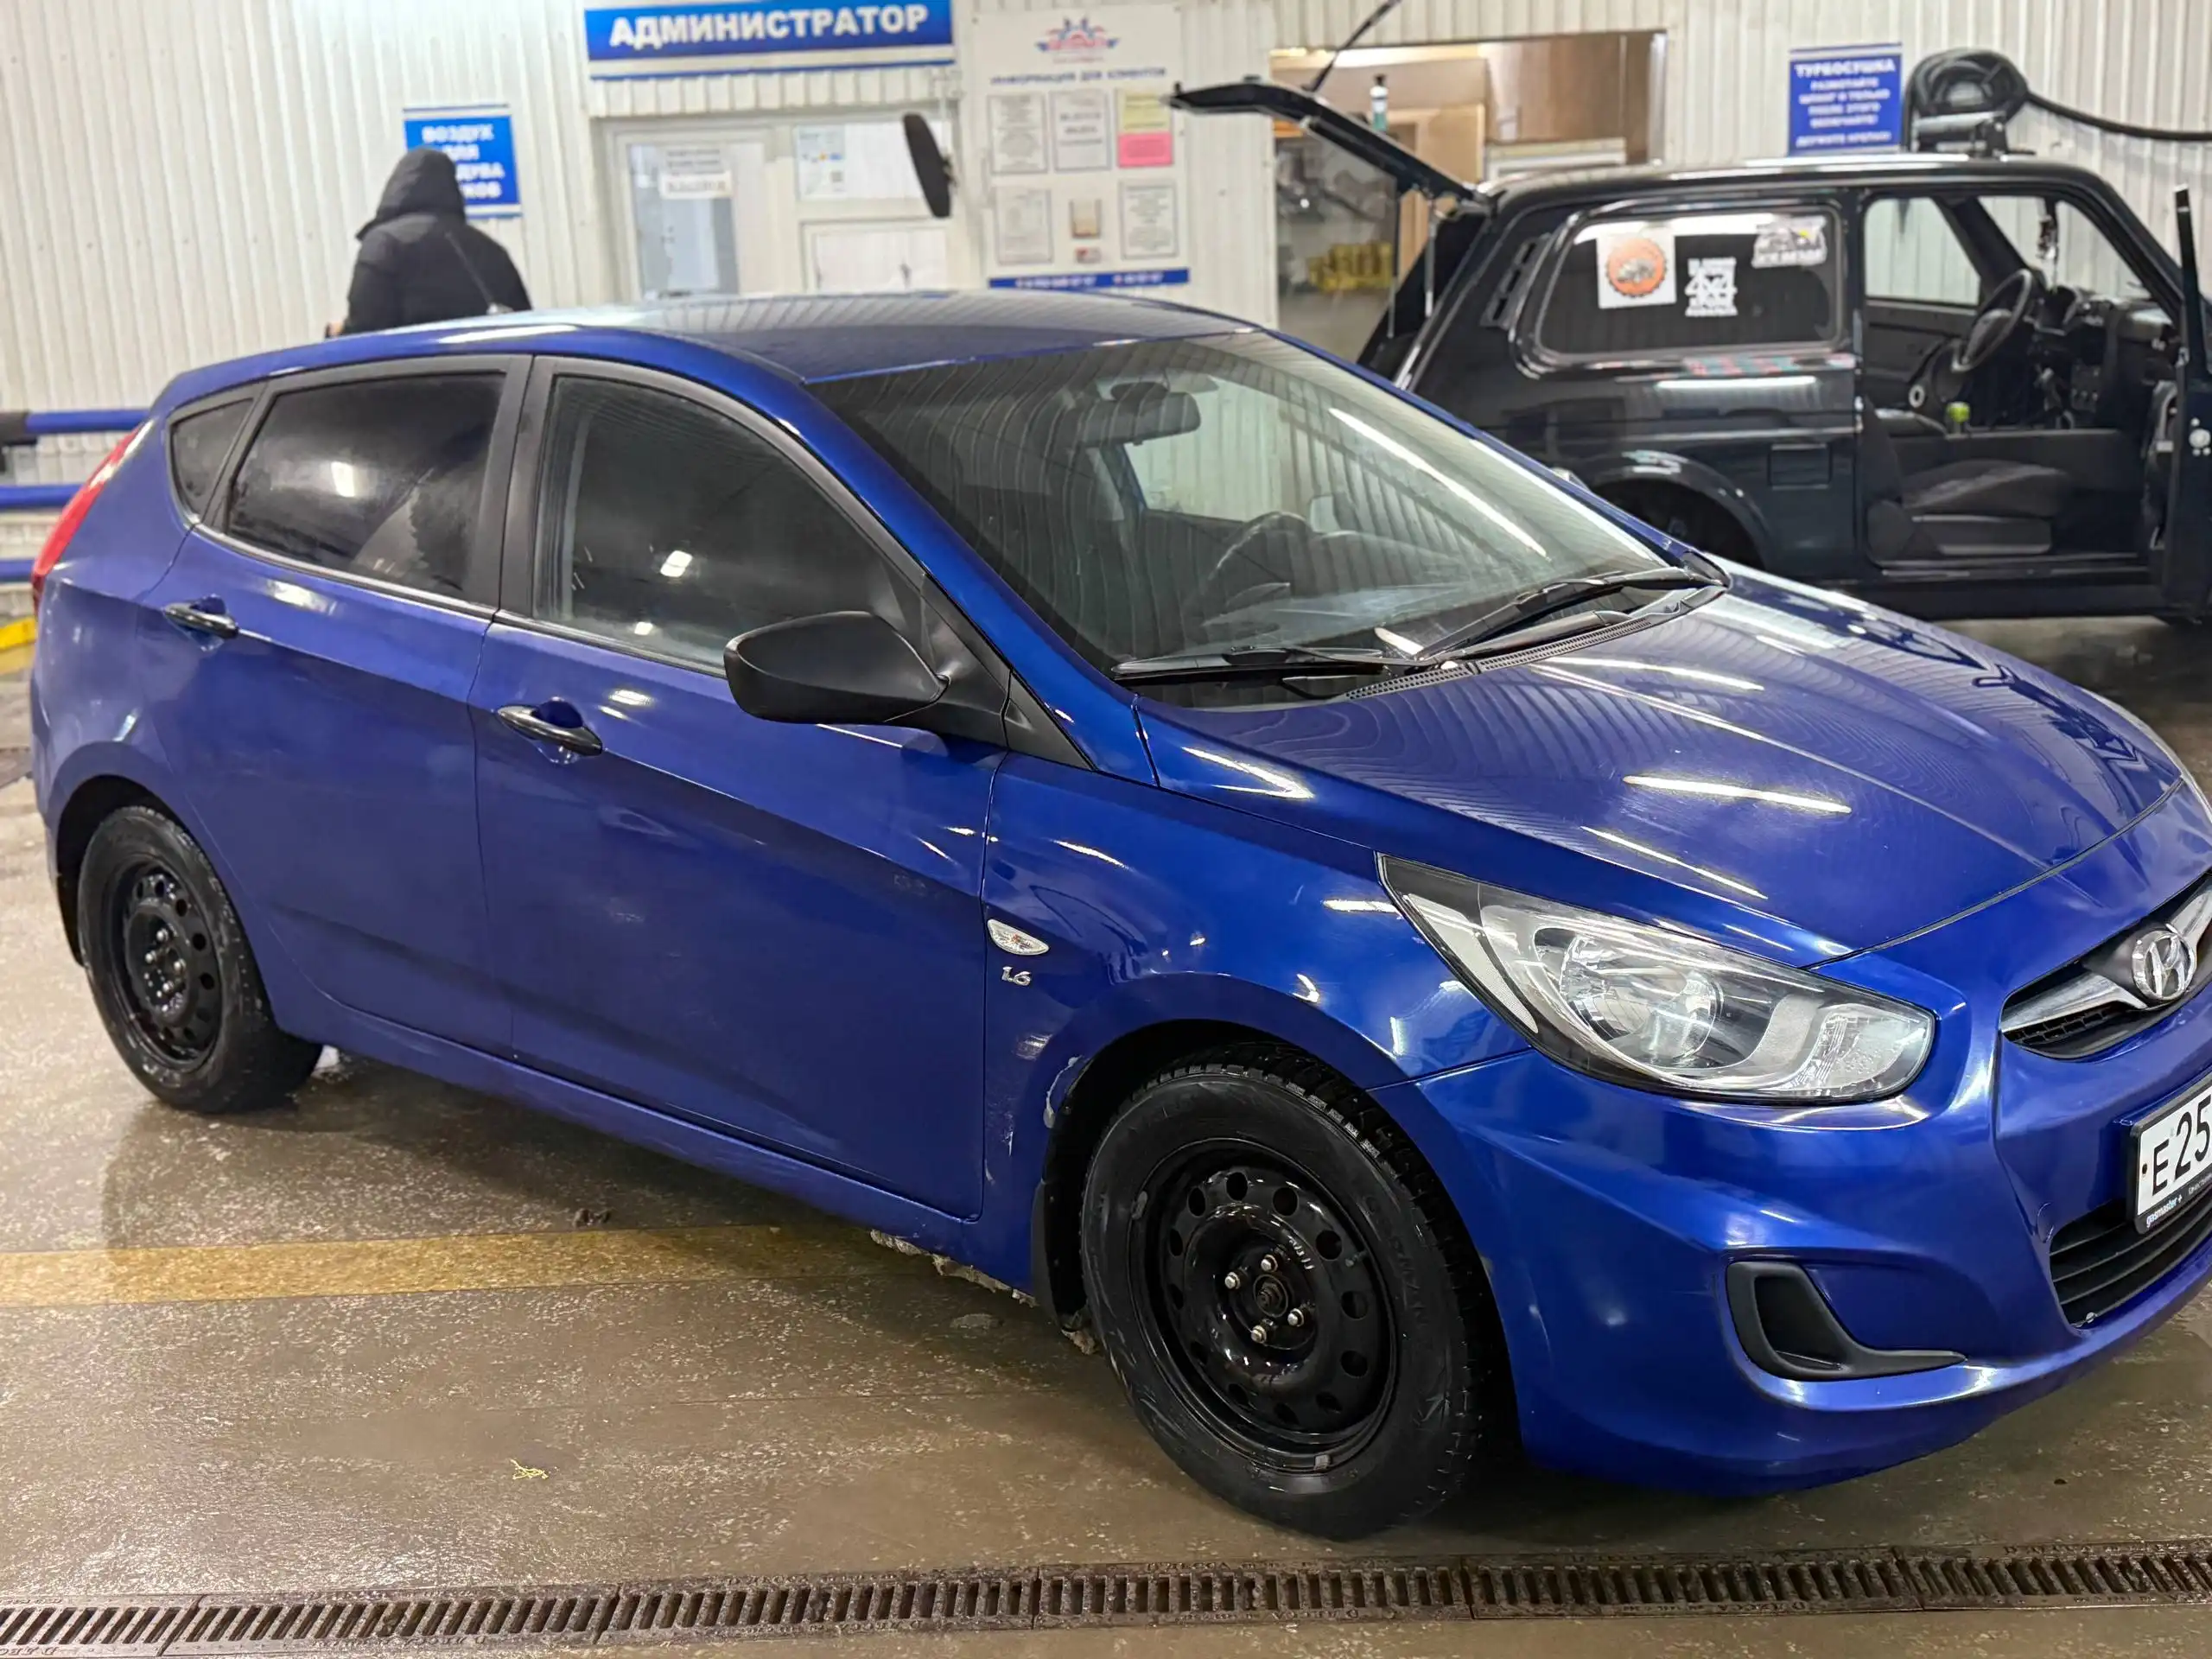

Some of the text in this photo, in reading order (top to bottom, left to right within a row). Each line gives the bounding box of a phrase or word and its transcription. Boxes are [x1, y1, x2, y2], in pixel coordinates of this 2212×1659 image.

[609, 4, 928, 50] АДМИНИСТРАТОР
[1795, 58, 1896, 78] ТУРБОСУШКА
[421, 123, 494, 144] ВОЗДУХ
[455, 162, 505, 181] ДУВА
[460, 181, 502, 200] КОВ
[1001, 966, 1033, 987] 1.6
